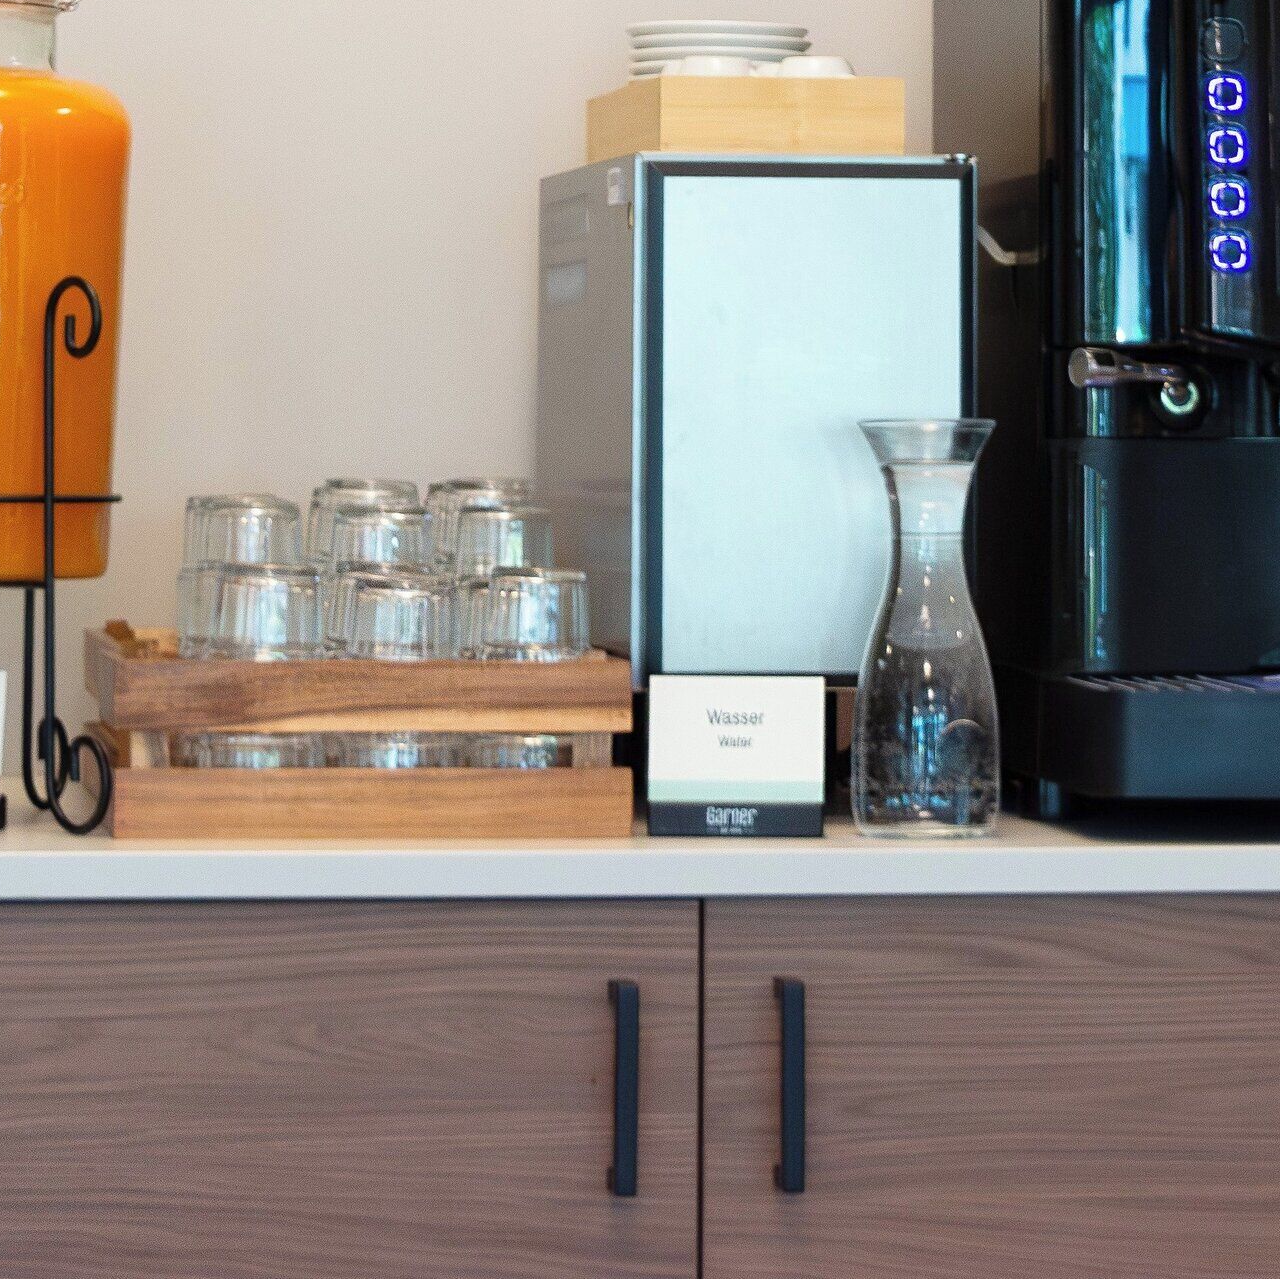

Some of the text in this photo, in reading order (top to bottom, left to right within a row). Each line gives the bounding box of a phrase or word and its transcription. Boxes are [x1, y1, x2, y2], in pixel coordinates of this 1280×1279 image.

[705, 708, 764, 726] Wasser
[718, 735, 753, 748] Water
[706, 805, 759, 827] Garner
